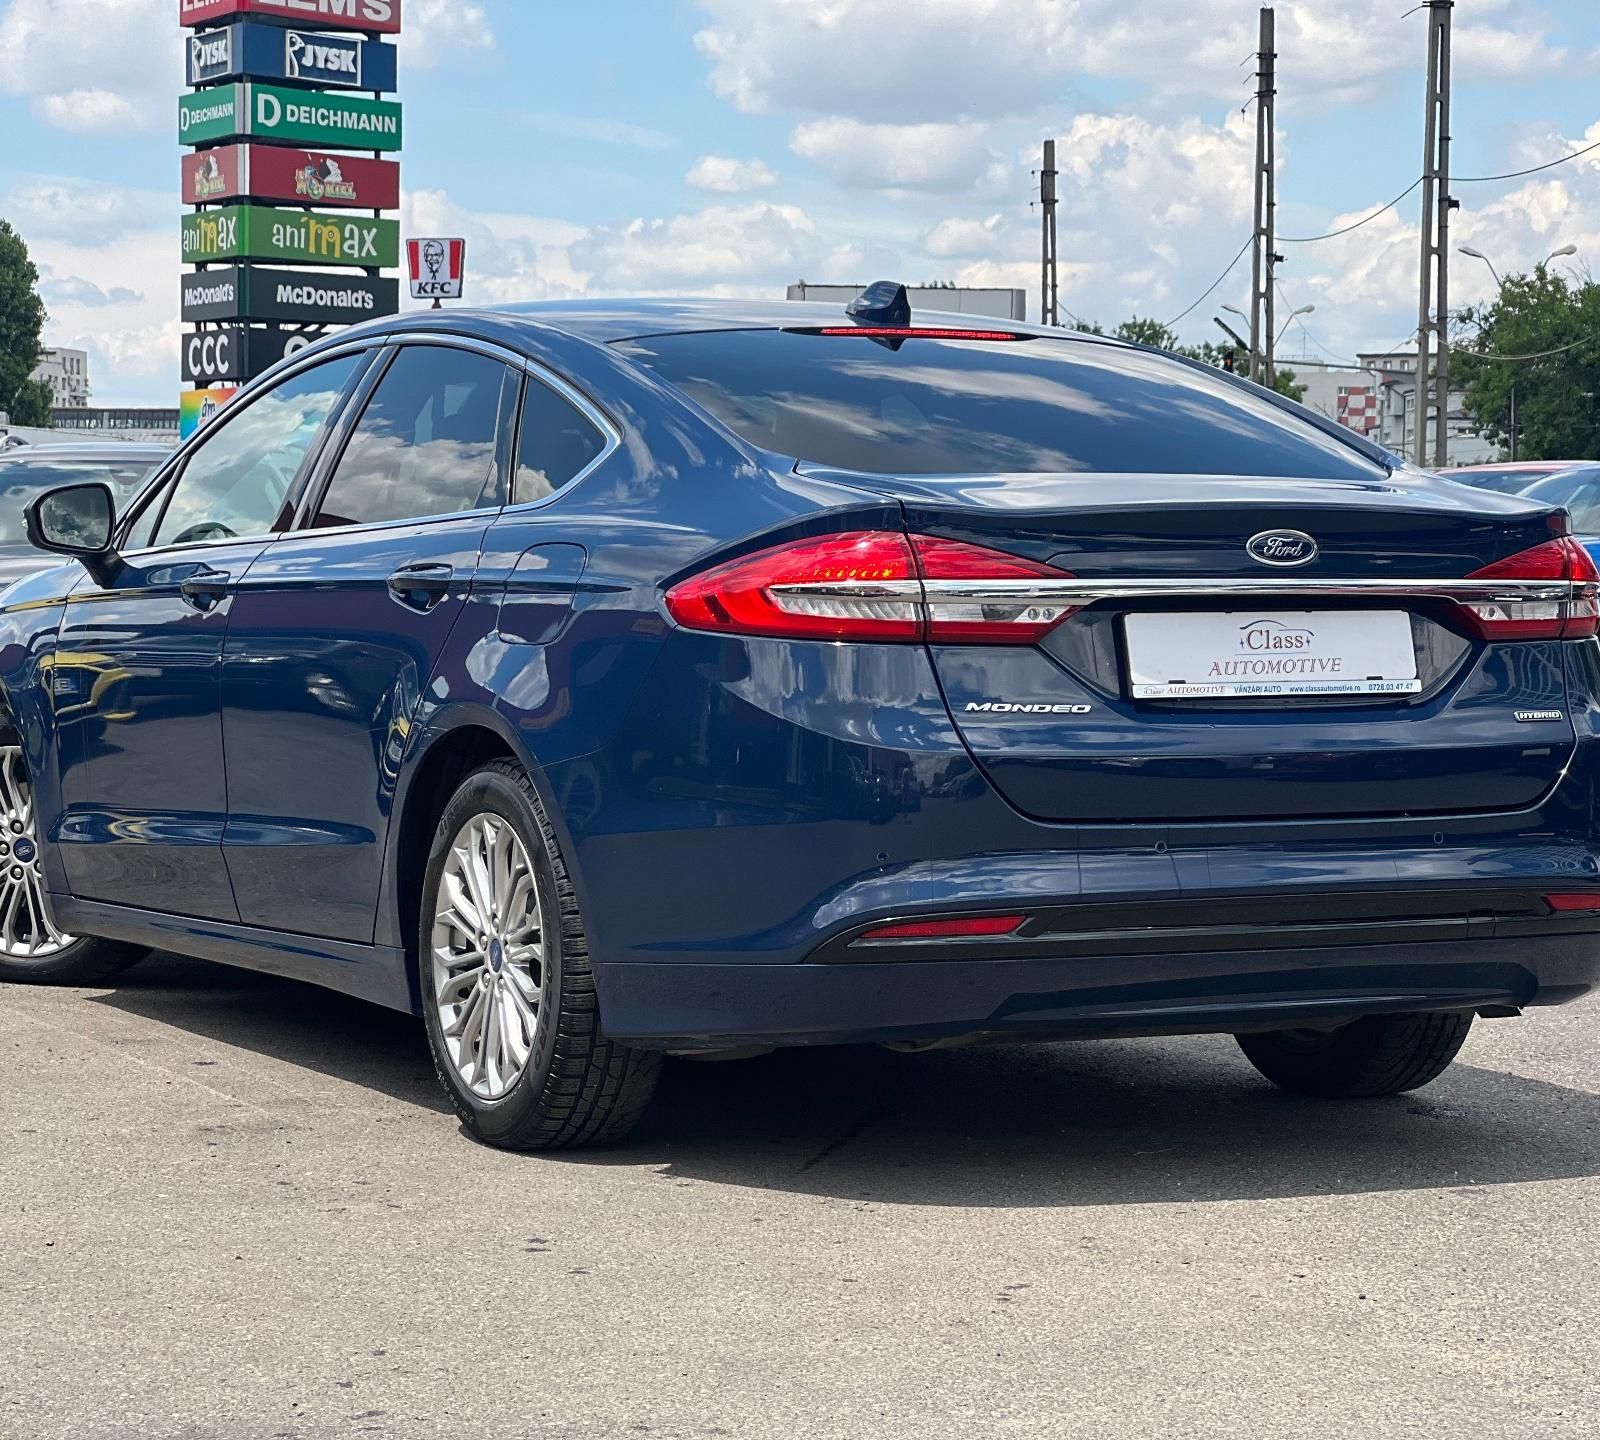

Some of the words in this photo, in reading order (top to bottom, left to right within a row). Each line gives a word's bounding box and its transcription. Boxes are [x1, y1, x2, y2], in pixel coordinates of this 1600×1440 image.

[200, 39, 228, 67] JYSK
[301, 44, 356, 73] JYSK
[191, 102, 233, 125] DEICHMANN
[286, 103, 396, 134] DEICHMANN
[183, 216, 236, 253] animax
[272, 216, 378, 258] animax
[184, 283, 234, 306] McDonald's
[276, 285, 374, 309] McDonald's
[416, 281, 451, 295] KFC
[188, 334, 229, 376] CCC
[1264, 537, 1303, 557] Ford
[1247, 629, 1304, 650] Class
[1208, 657, 1342, 677] AUTOMOTIVE
[1168, 686, 1226, 694] AUTOMOTIVE
[1264, 685, 1282, 693] AUTO
[1289, 684, 1360, 693] www.classautomotive.ro
[1368, 682, 1413, 691] 0728.03.47.47
[964, 702, 1092, 713] MONDEO
[1519, 711, 1560, 719] HYBRID
